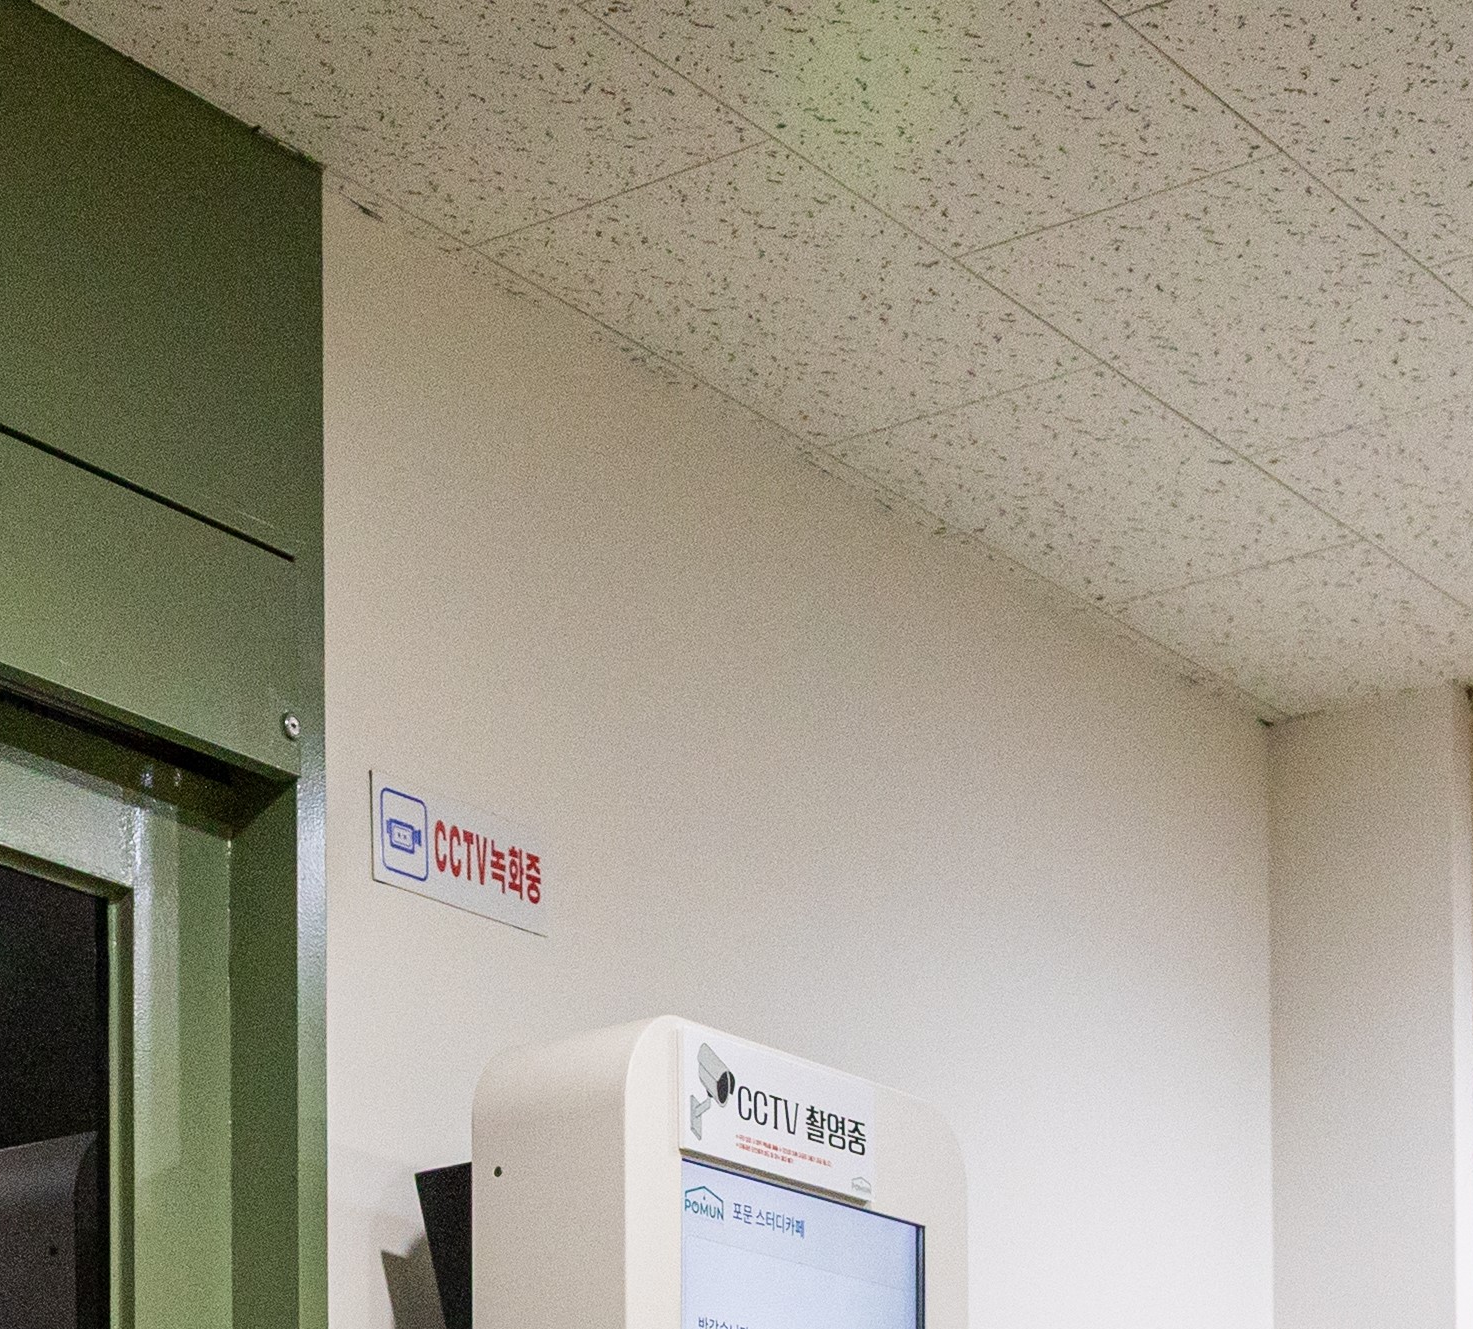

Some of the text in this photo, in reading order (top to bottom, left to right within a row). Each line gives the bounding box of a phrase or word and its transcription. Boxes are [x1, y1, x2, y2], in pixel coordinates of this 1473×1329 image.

[434, 820, 541, 904] CCTV녹화중
[738, 1086, 799, 1135] CCTV
[806, 1105, 866, 1155] 촬영중
[685, 1199, 724, 1220] POMUN
[733, 1202, 805, 1239] 포문 스터디카페
